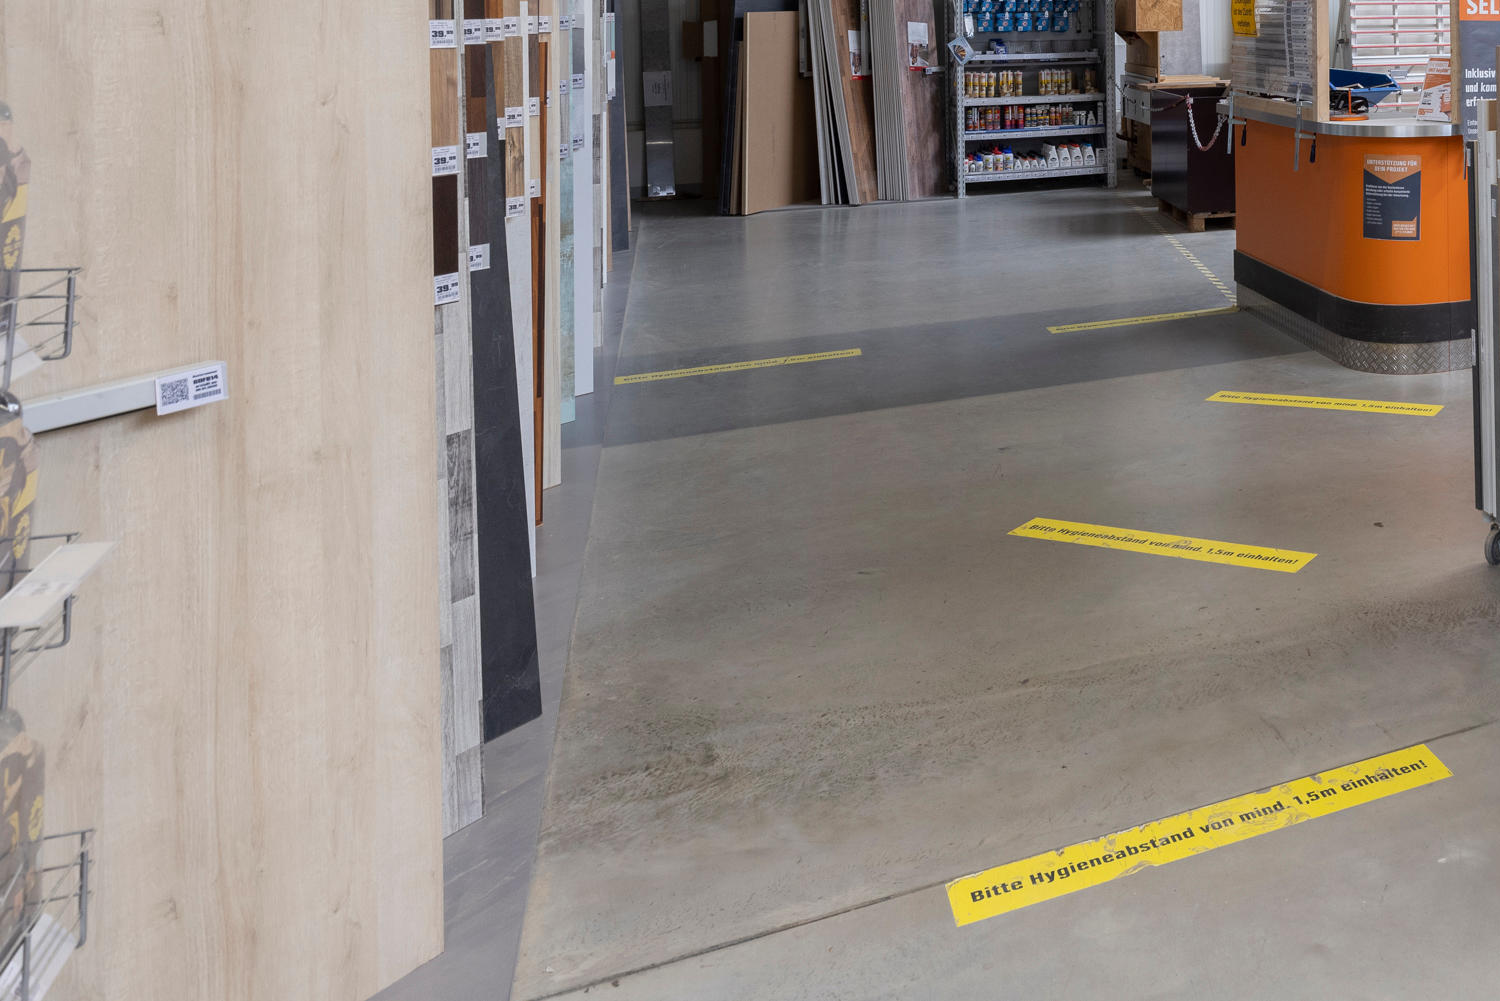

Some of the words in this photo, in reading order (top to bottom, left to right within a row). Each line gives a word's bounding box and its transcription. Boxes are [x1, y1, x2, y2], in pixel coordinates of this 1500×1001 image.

[1465, 82, 1478, 93] und
[1480, 82, 1497, 93] kom
[1029, 524, 1056, 533] Bitte
[1057, 528, 1148, 545] Hygieneabstand
[1171, 543, 1202, 552] mind.
[1206, 548, 1233, 557] 1,5m
[1236, 551, 1298, 565] einhalten!
[970, 879, 1023, 903] Bitte
[1029, 827, 1195, 884] Hygieneabstand
[1199, 816, 1235, 834] von
[1239, 801, 1290, 823] mind.
[1293, 787, 1337, 806] 1,5m
[1340, 759, 1428, 793] einhalten!
